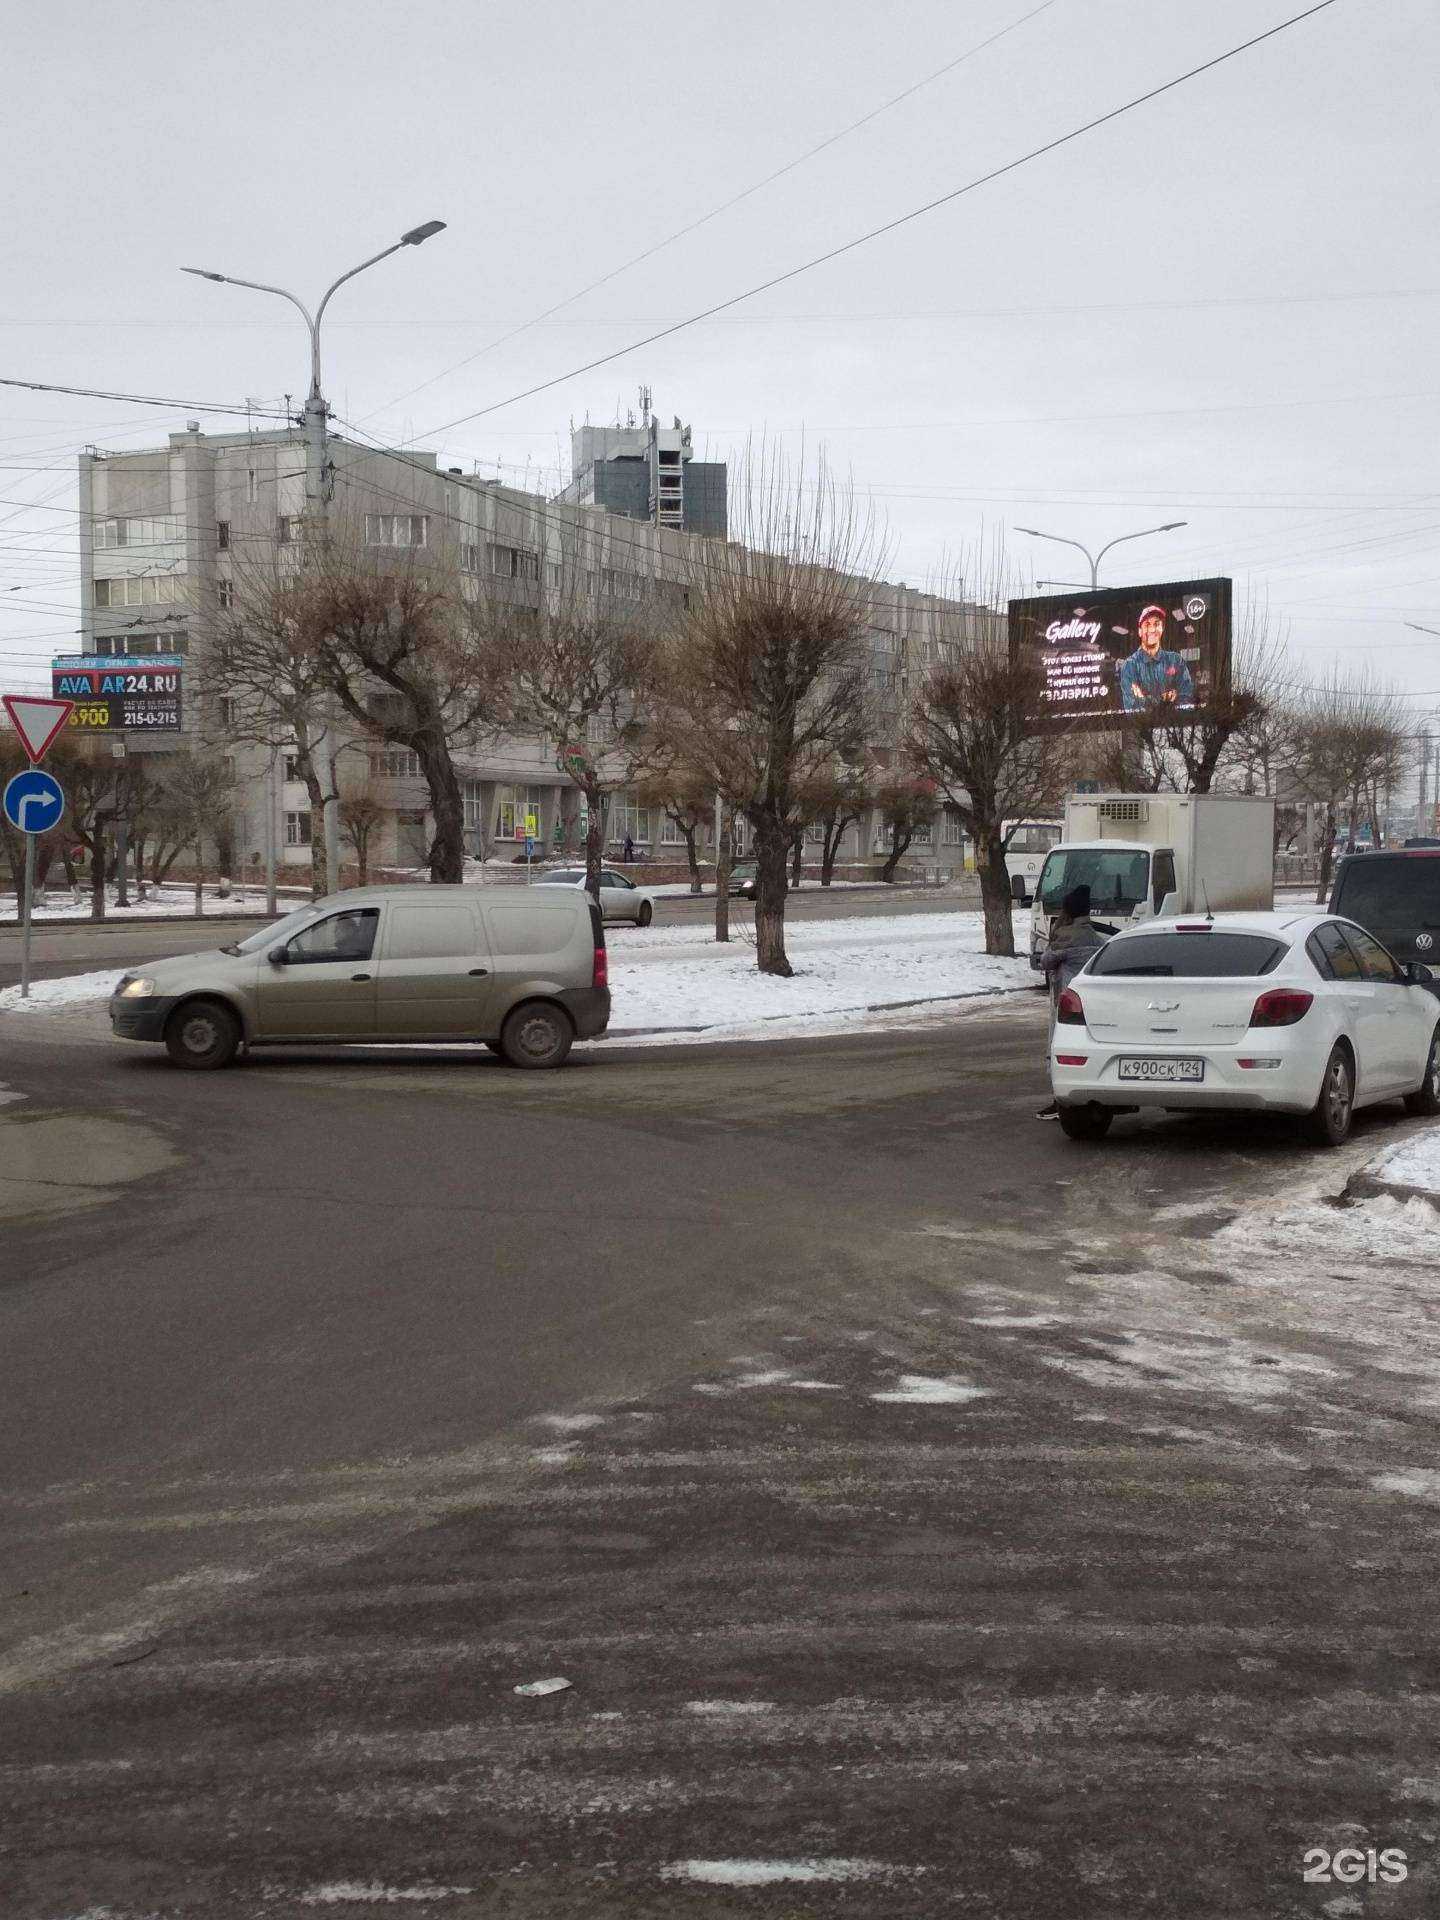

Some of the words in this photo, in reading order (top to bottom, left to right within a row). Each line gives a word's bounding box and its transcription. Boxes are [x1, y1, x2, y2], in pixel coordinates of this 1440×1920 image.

[1045, 619, 1101, 643] Gallery
[59, 673, 177, 694] AVATAR24.RU
[124, 712, 177, 725] 215-0-215
[1179, 1062, 1199, 1073] 124
